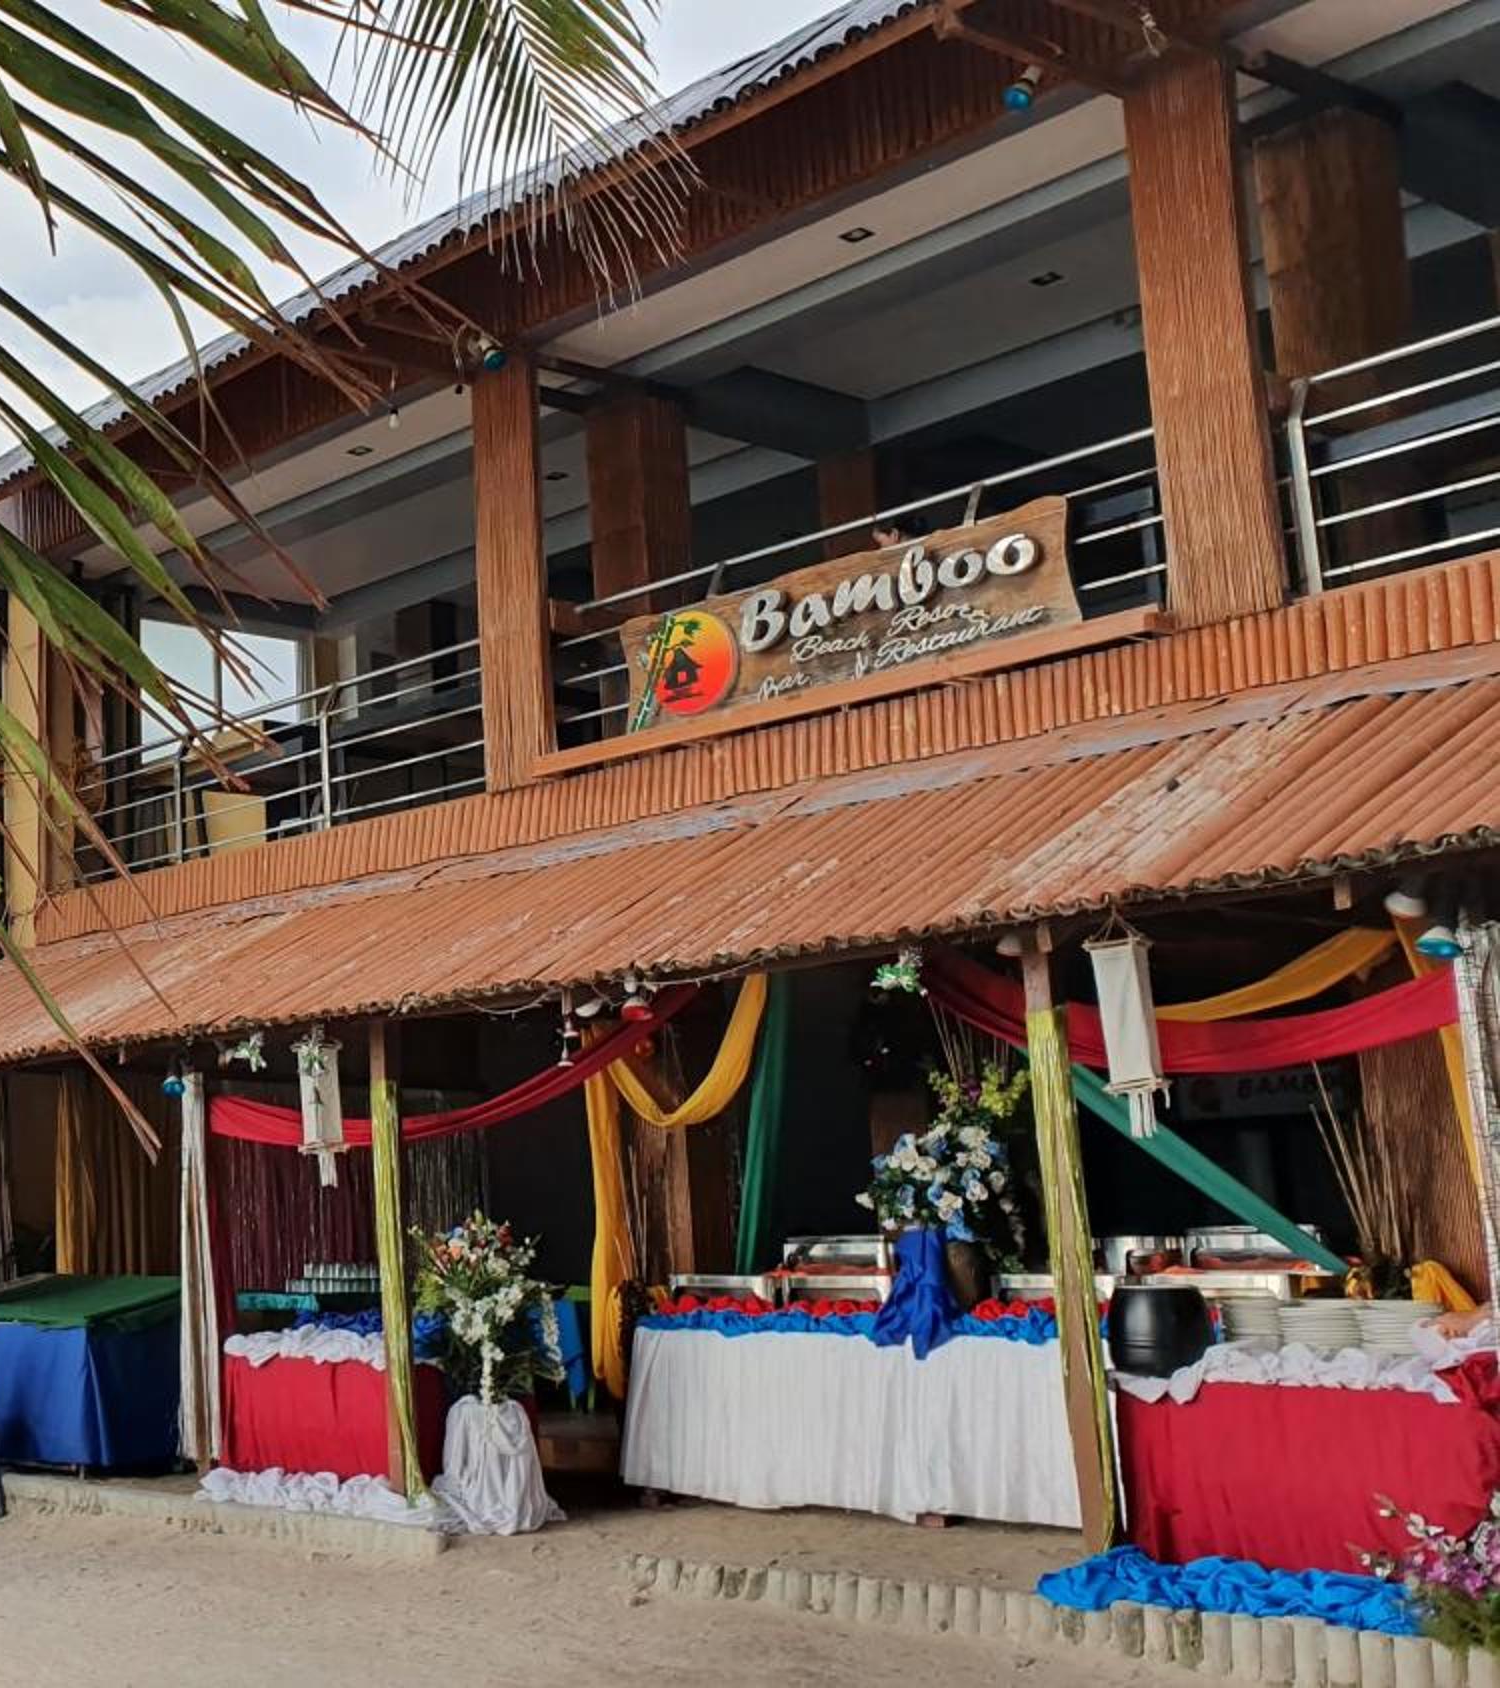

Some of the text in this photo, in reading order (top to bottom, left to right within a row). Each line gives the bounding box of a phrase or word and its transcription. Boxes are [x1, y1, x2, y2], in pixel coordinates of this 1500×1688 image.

[740, 533, 1036, 652] Bamboo
[790, 630, 869, 664] Beach
[874, 605, 1044, 669] Restaurant
